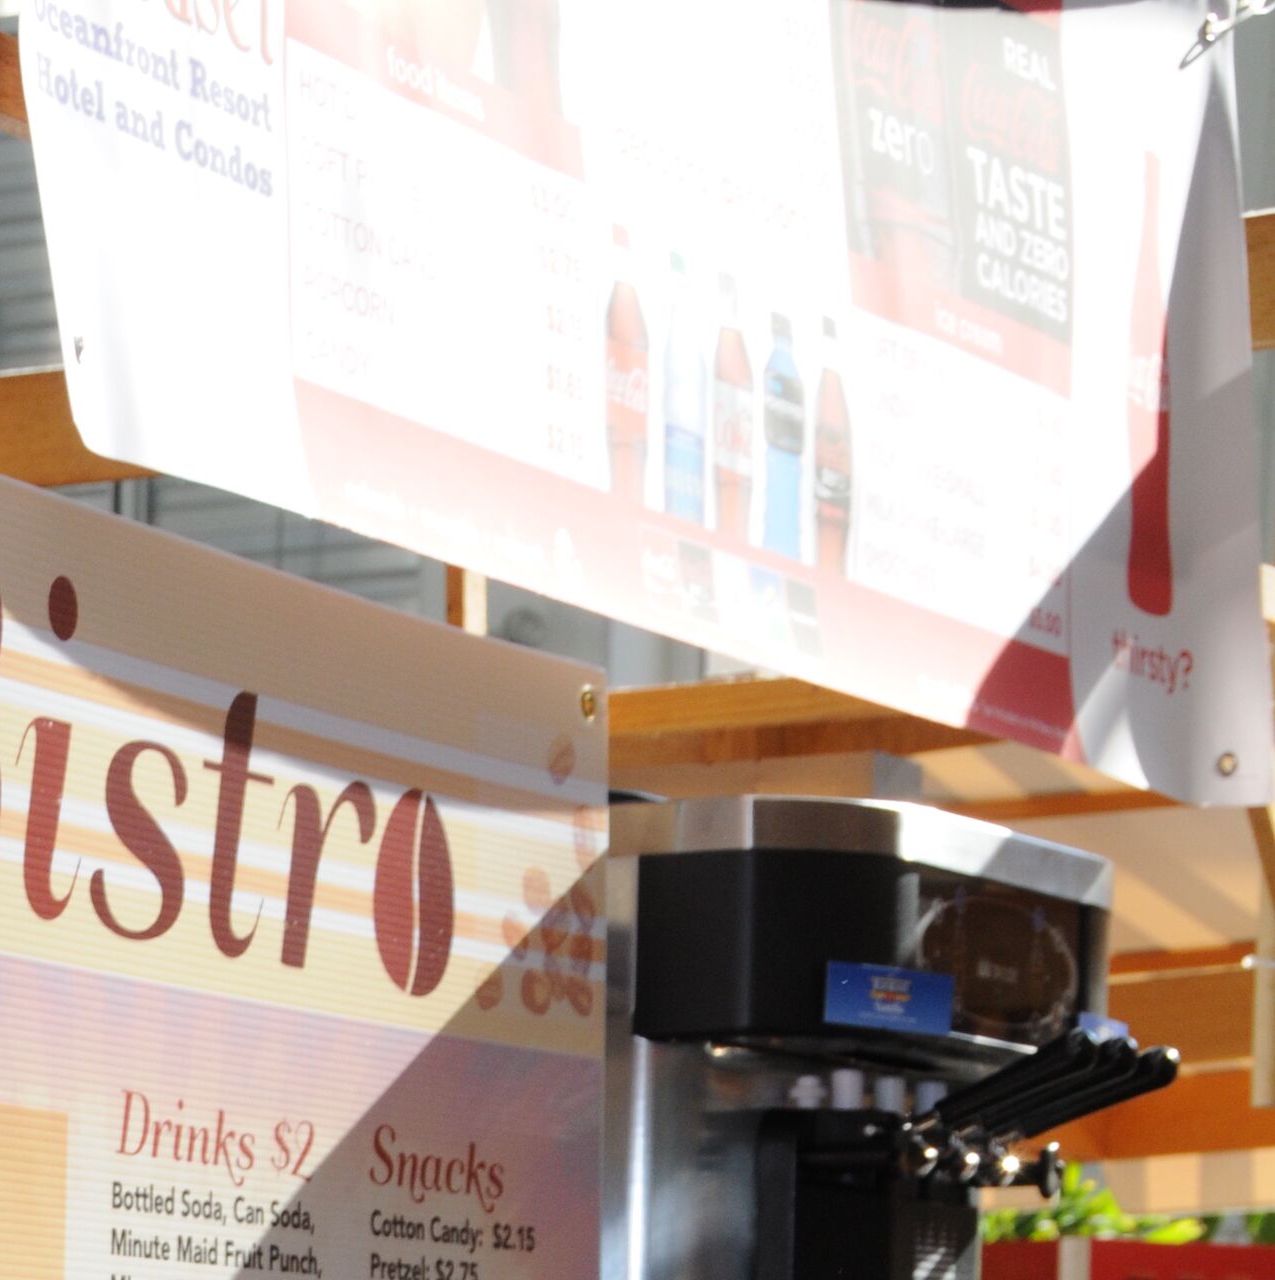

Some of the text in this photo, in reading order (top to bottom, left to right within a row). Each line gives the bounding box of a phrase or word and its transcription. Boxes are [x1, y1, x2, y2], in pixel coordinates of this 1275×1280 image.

[34, 0, 180, 91] Oceanfront
[189, 56, 272, 133] Resort
[1002, 36, 1057, 92] REAL
[37, 50, 106, 124] Hotel
[115, 100, 166, 151] and
[175, 119, 273, 197] Condos
[869, 106, 934, 176] zero
[966, 145, 1067, 240] TASTE
[975, 211, 1069, 282] AND ZERO
[977, 252, 1067, 322] CALORIES
[115, 1088, 315, 1187] Drinks $2
[369, 1123, 504, 1213] Snacks
[111, 1180, 315, 1236] Bottled Soda, Can Soda,
[370, 1209, 536, 1254] Cotton Candy: $2.15
[110, 1227, 323, 1280] Minute Maid Fruit Punch,
